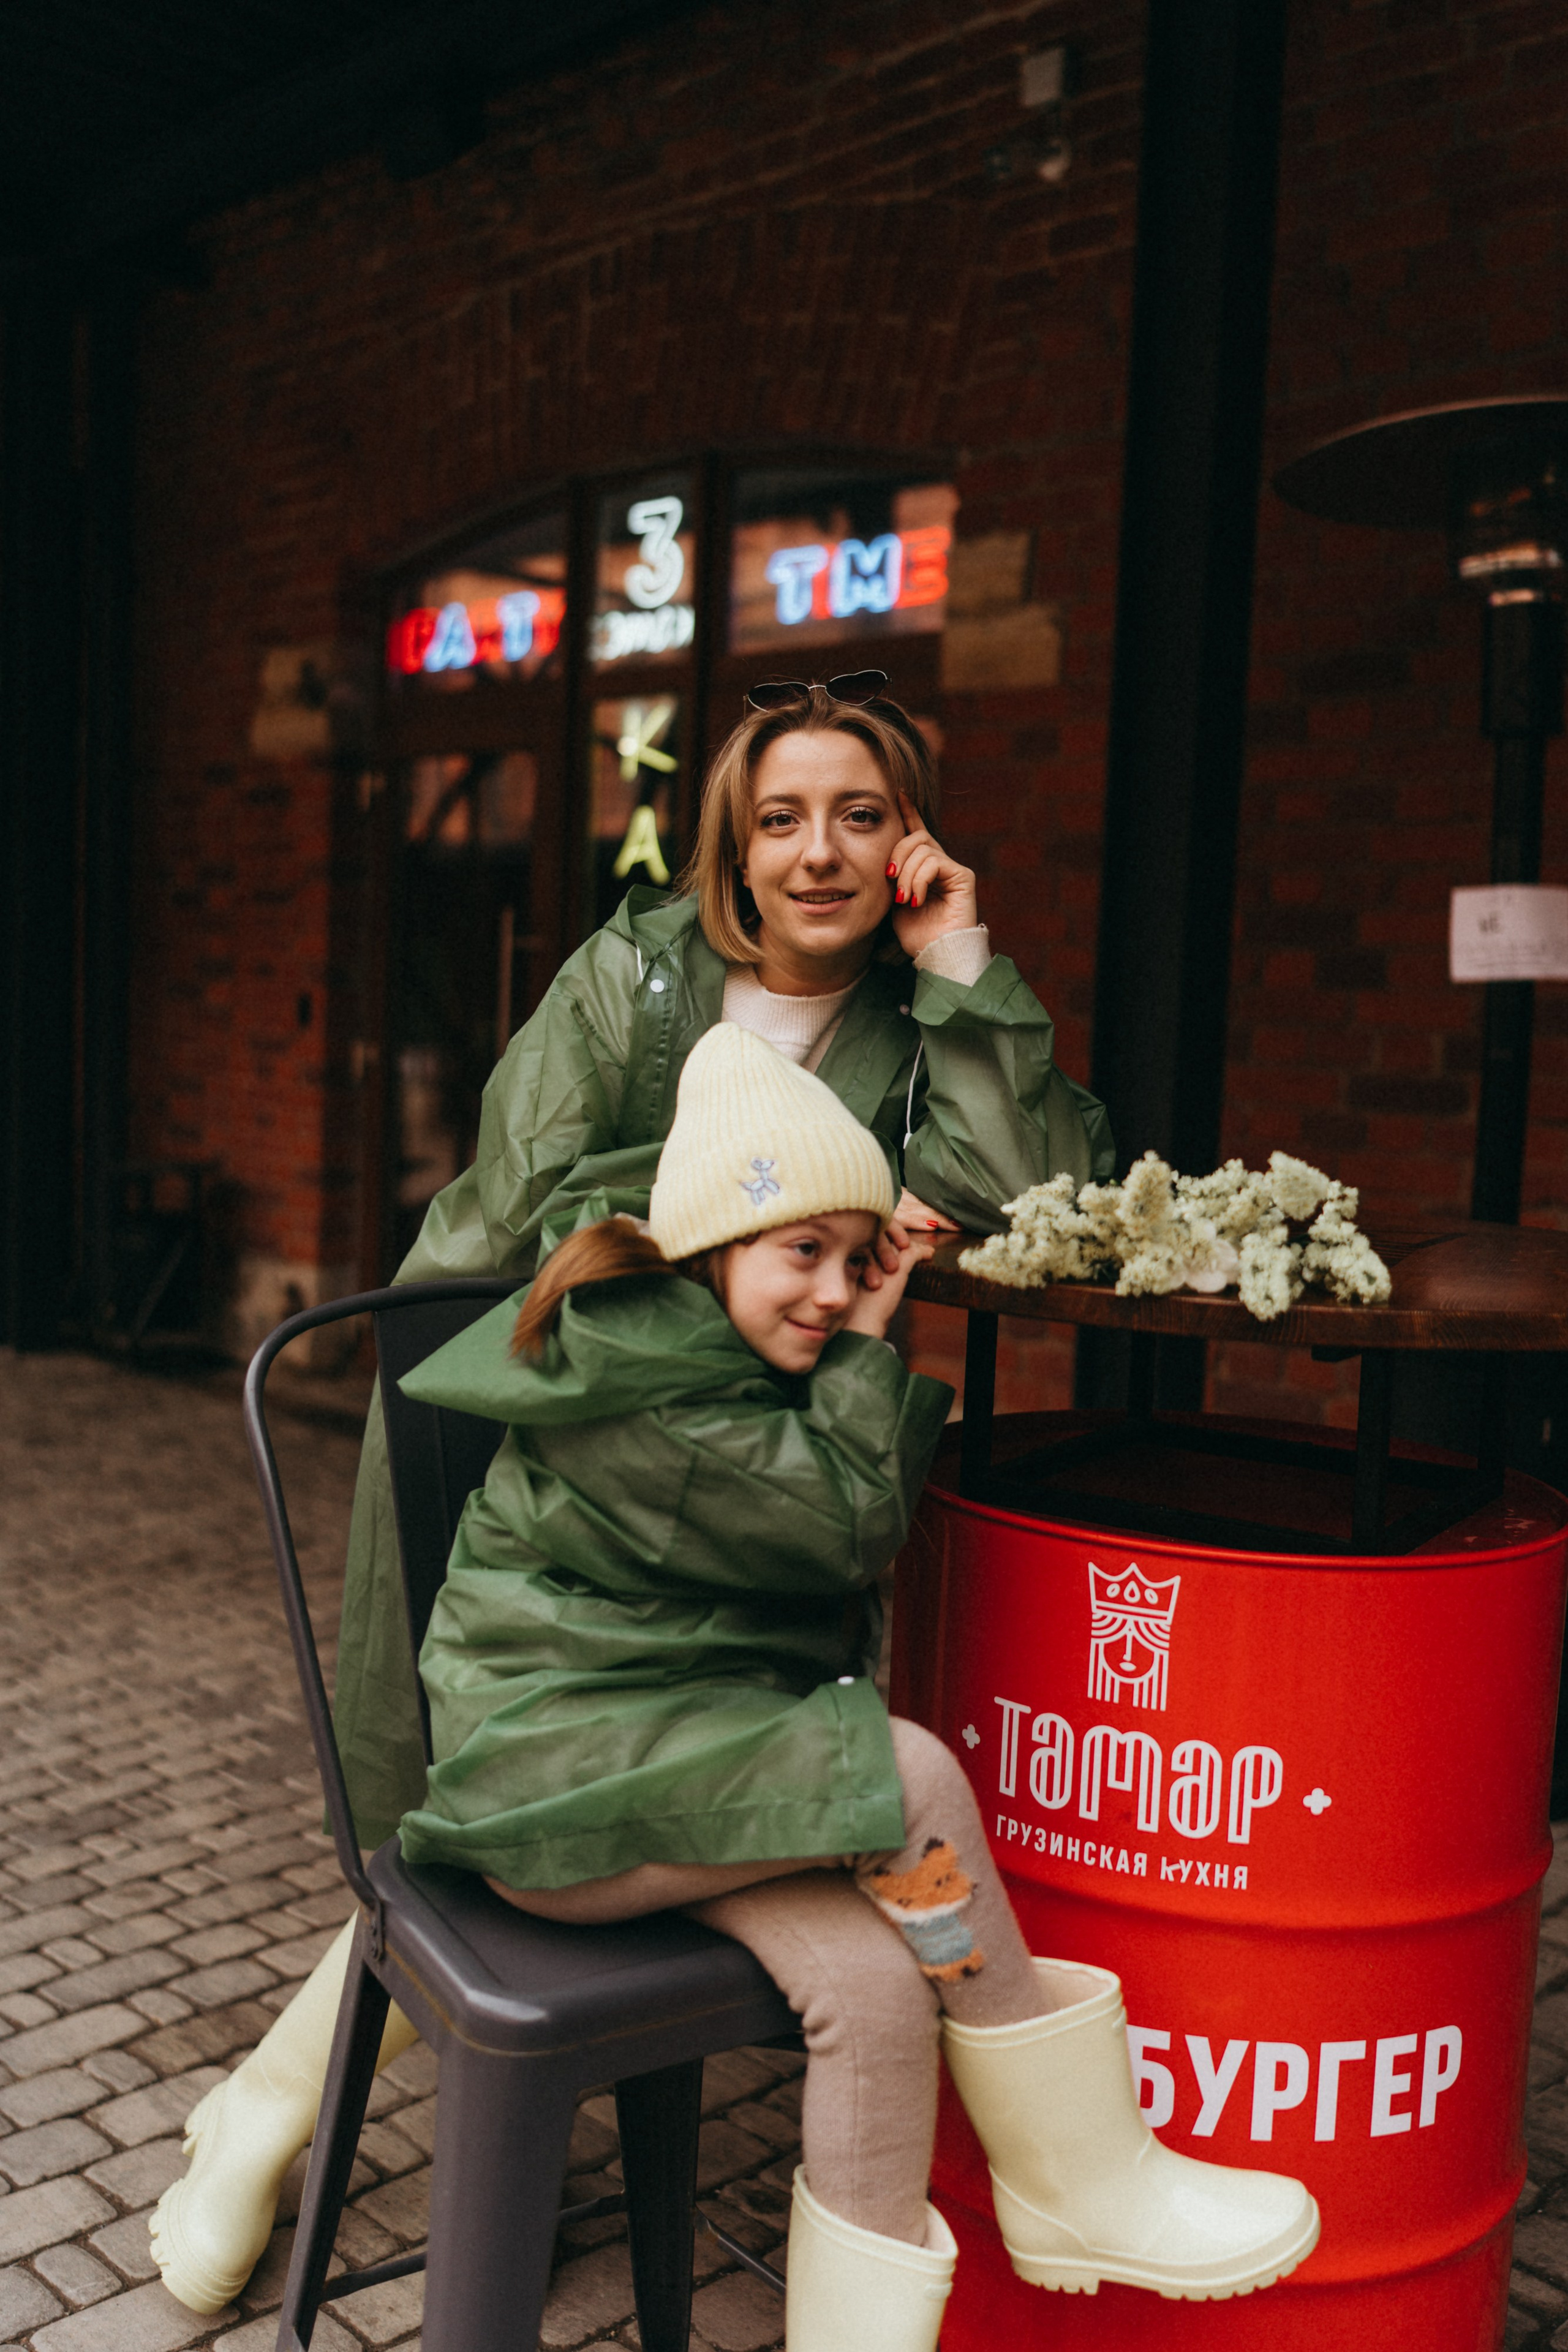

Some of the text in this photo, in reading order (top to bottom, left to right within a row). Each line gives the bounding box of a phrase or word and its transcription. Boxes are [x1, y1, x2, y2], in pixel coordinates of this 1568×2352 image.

[767, 526, 951, 625] TIME
[996, 1814, 1248, 1890] ГРУЗИНСКАЯ КУХНЯ
